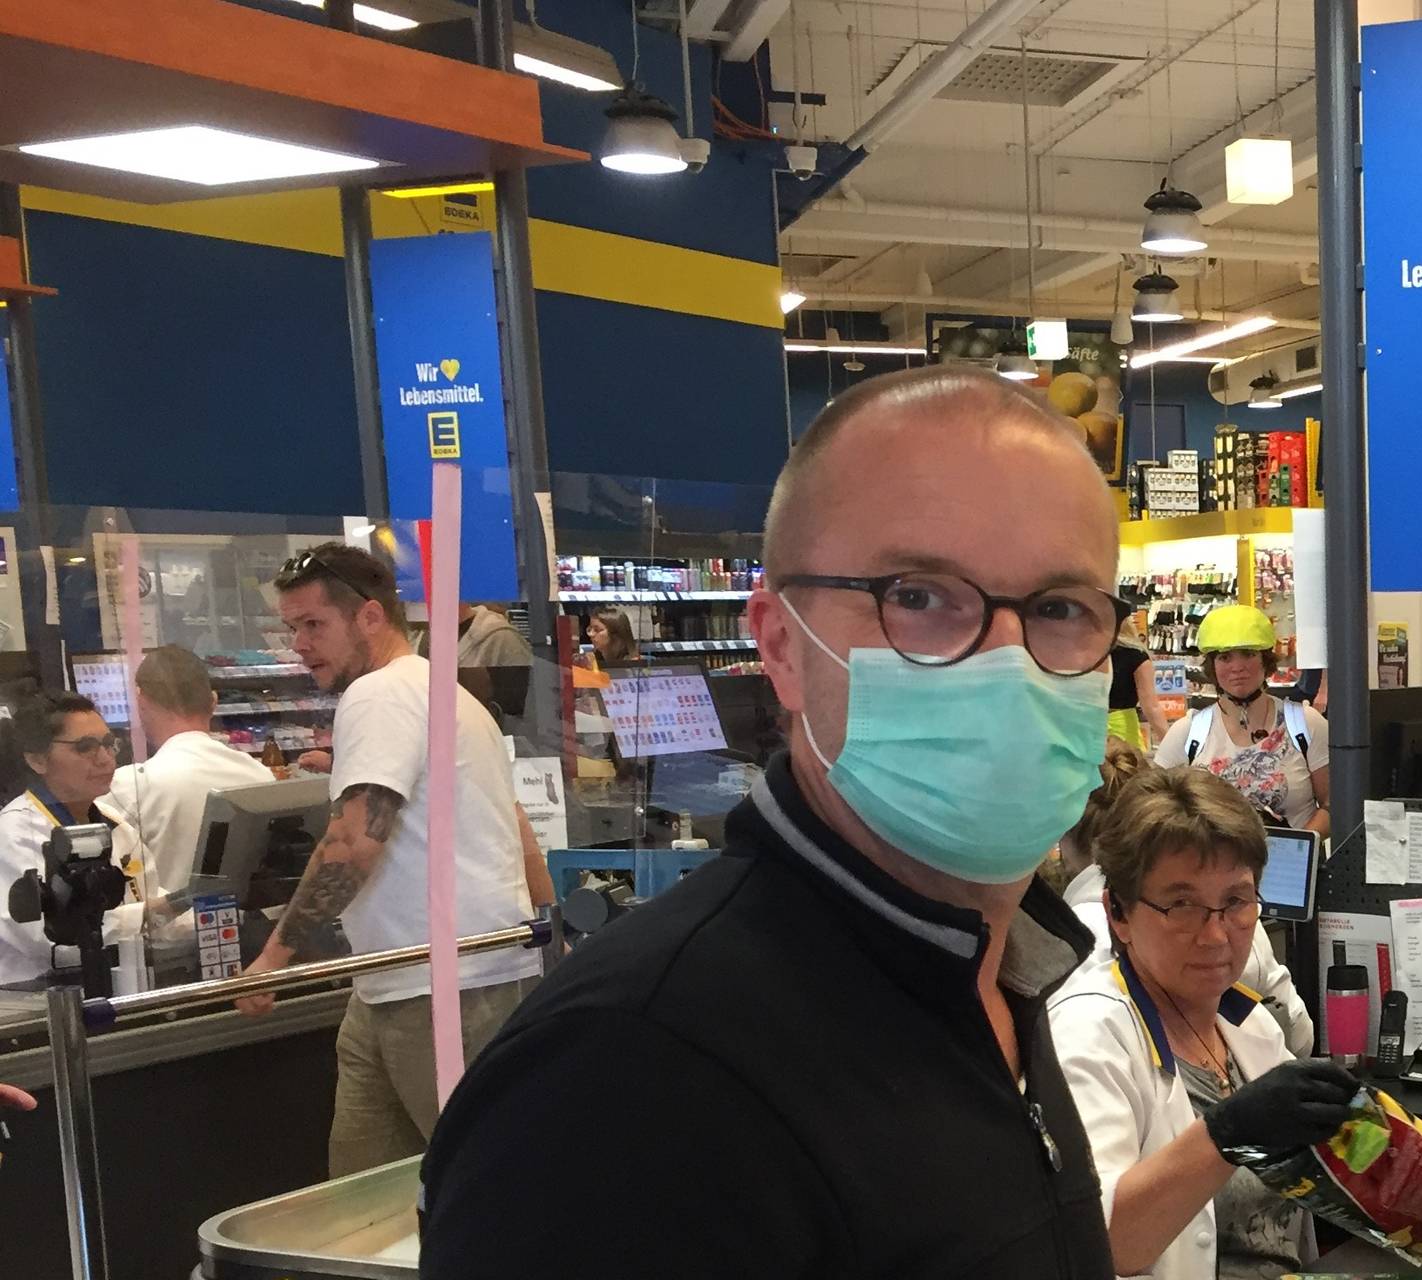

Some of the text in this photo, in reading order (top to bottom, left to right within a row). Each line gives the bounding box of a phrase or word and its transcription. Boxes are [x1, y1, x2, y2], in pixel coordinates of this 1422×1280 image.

[444, 206, 480, 222] EDEKA
[415, 362, 439, 382] Wir
[399, 382, 484, 406] Lebensmittel.
